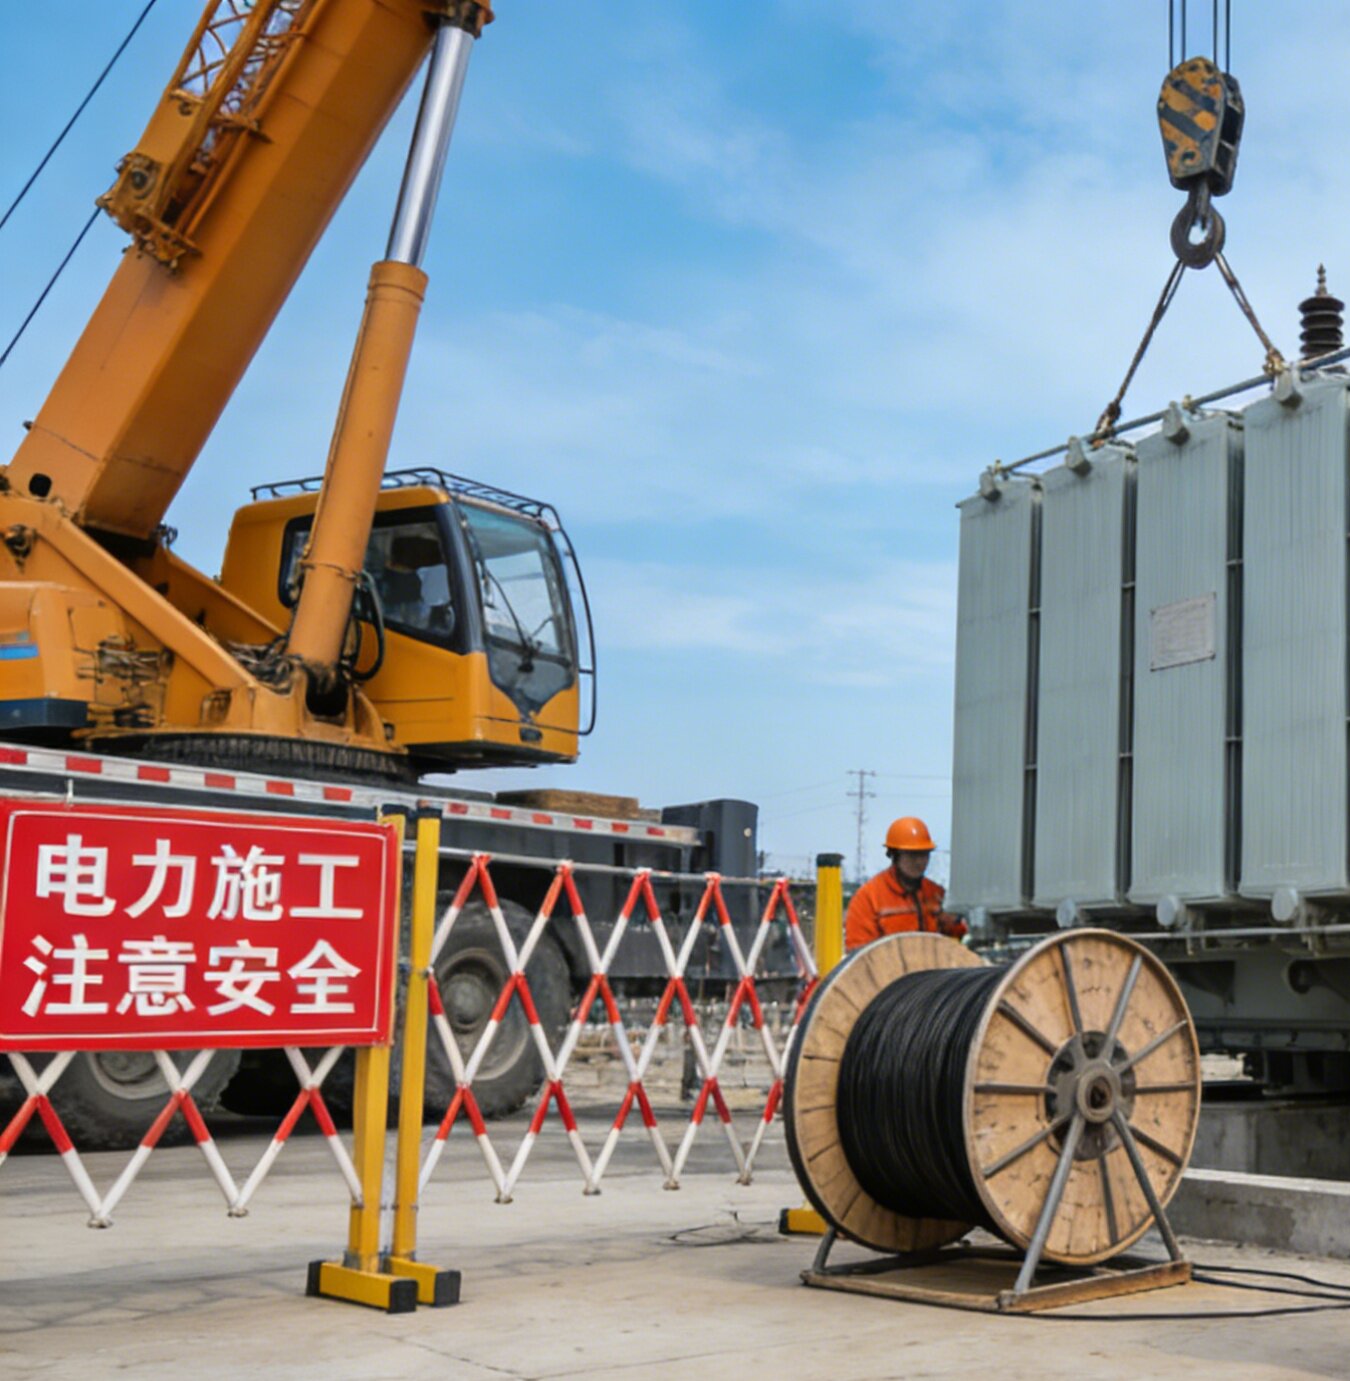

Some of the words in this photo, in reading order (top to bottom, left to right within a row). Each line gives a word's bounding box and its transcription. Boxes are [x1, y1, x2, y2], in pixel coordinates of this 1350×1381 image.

[36, 833, 364, 921] 电力施工
[21, 933, 362, 1017] 注意安全
